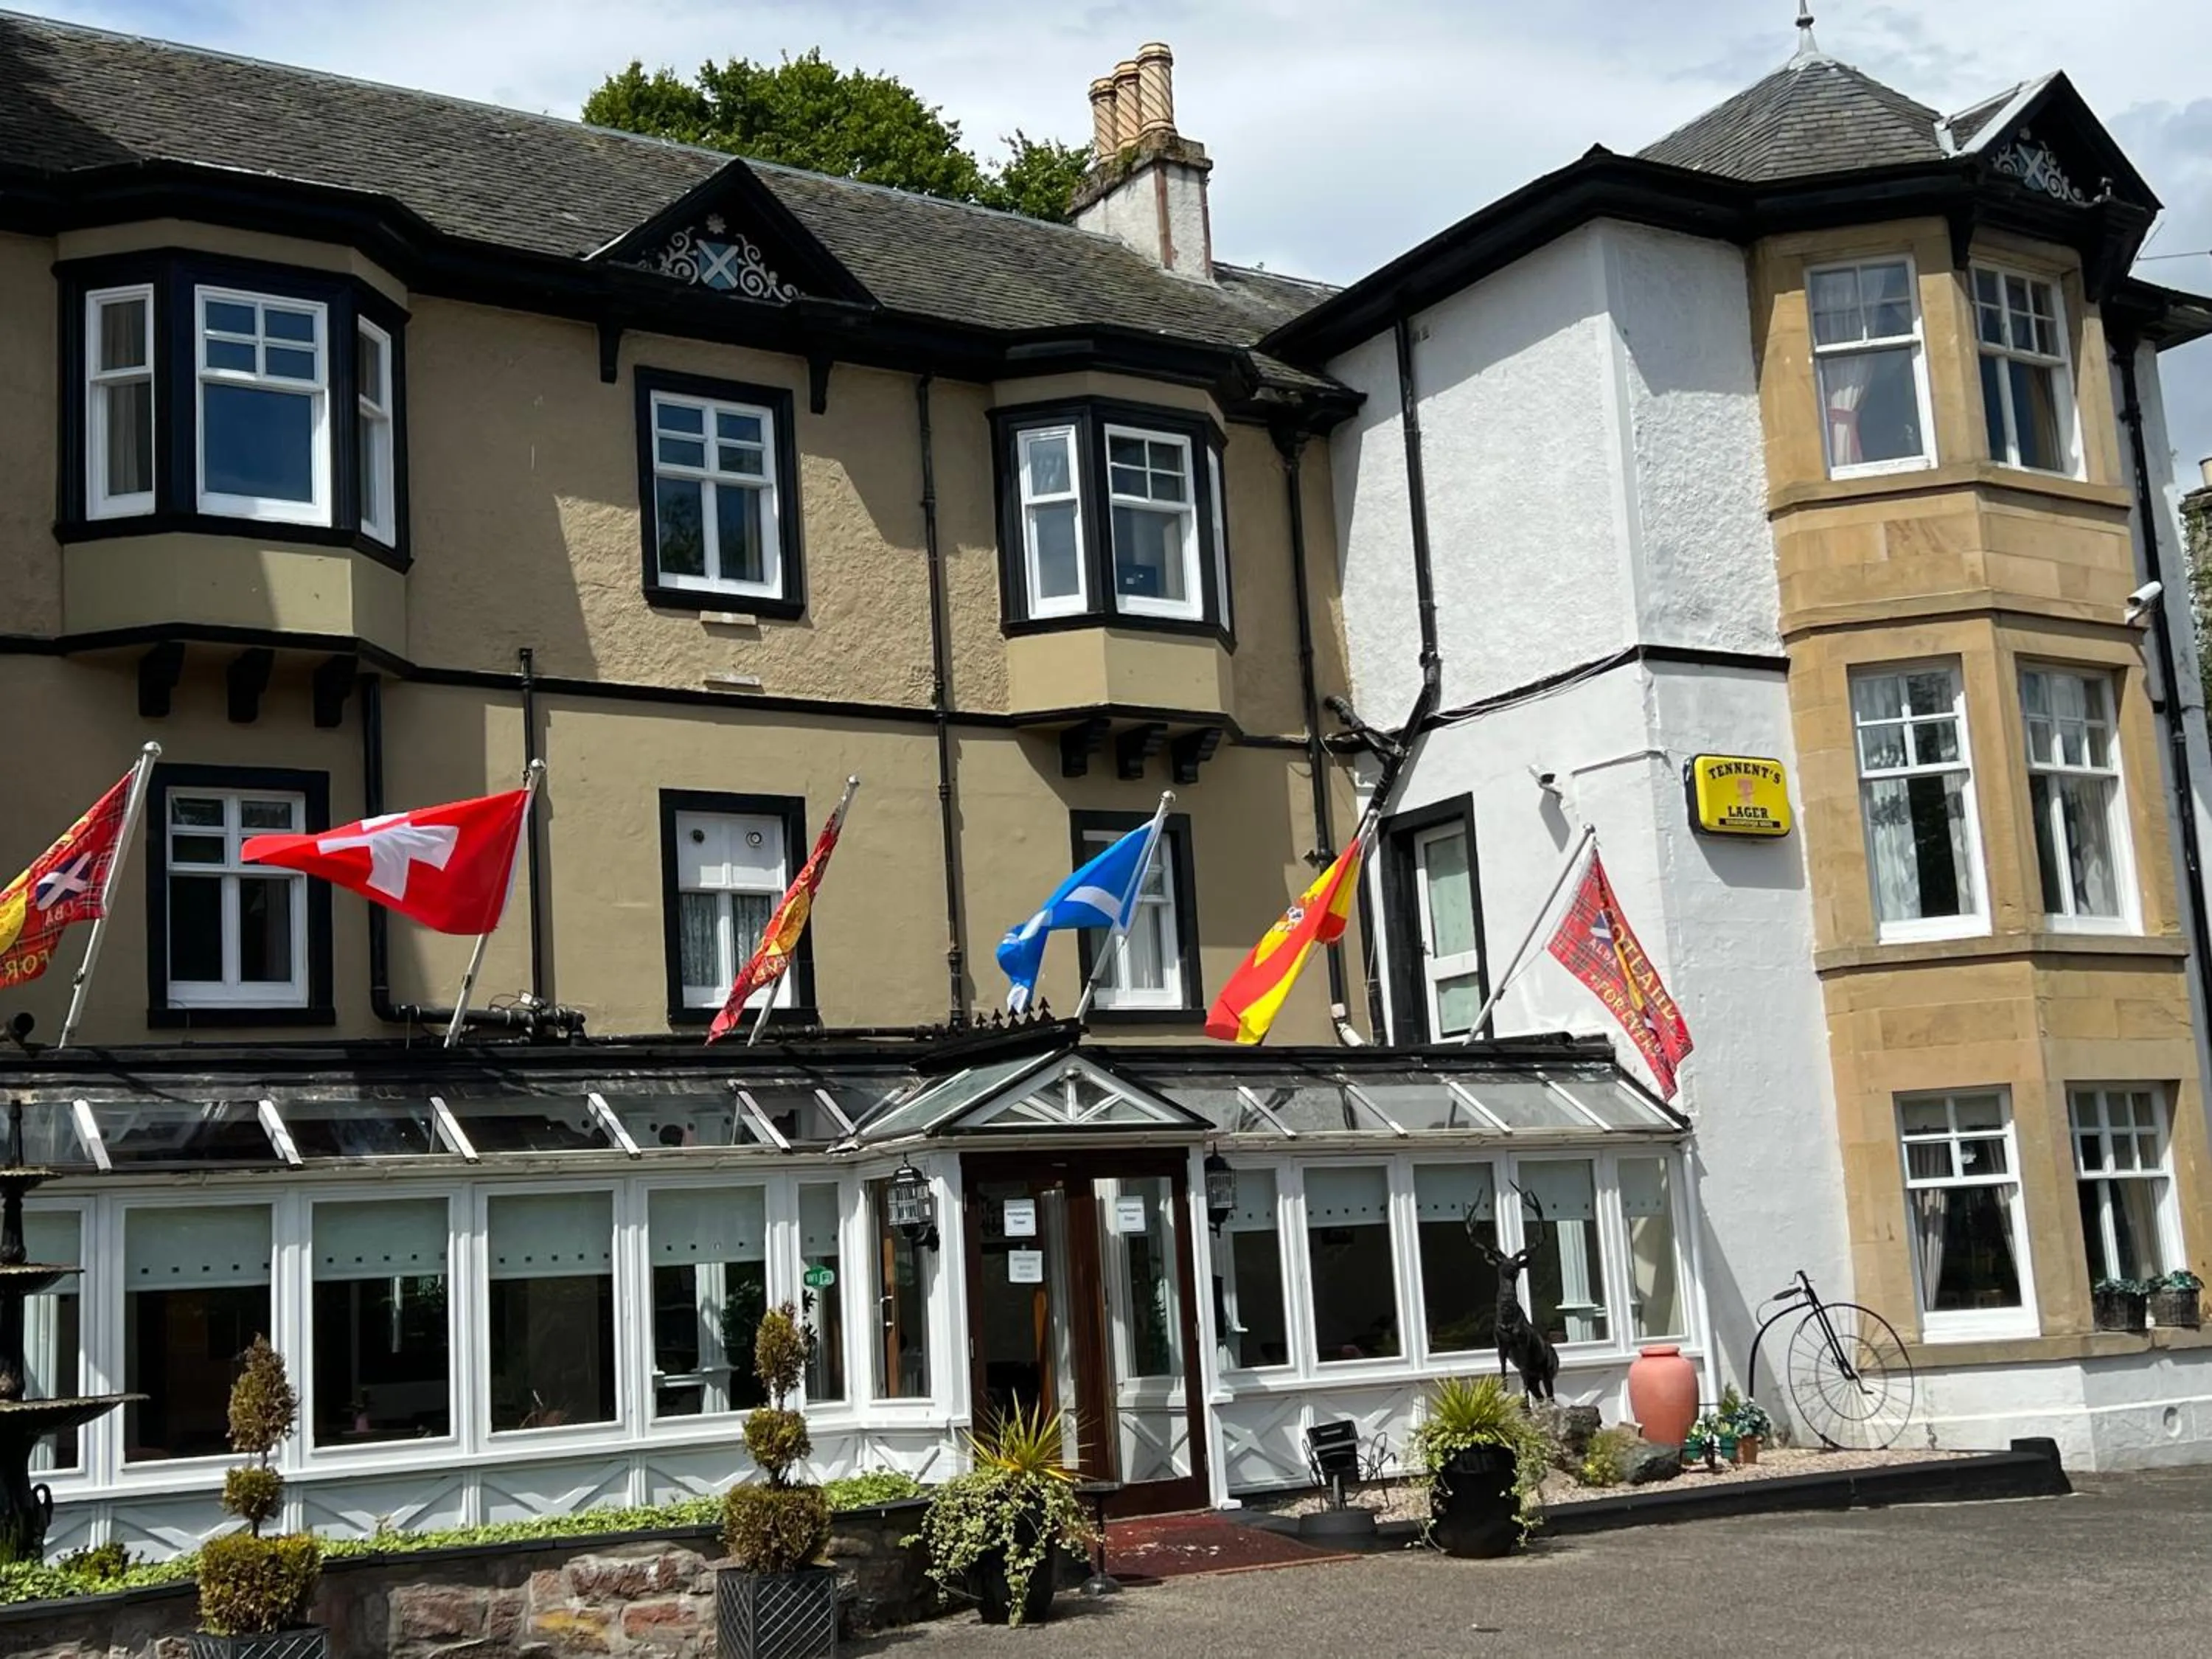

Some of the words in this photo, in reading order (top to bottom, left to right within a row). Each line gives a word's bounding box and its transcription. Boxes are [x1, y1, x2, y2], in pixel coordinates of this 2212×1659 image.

[1708, 762, 1781, 785] TENNENT'S
[1728, 805, 1769, 818] LAGER
[1589, 939, 1618, 970] ALBA
